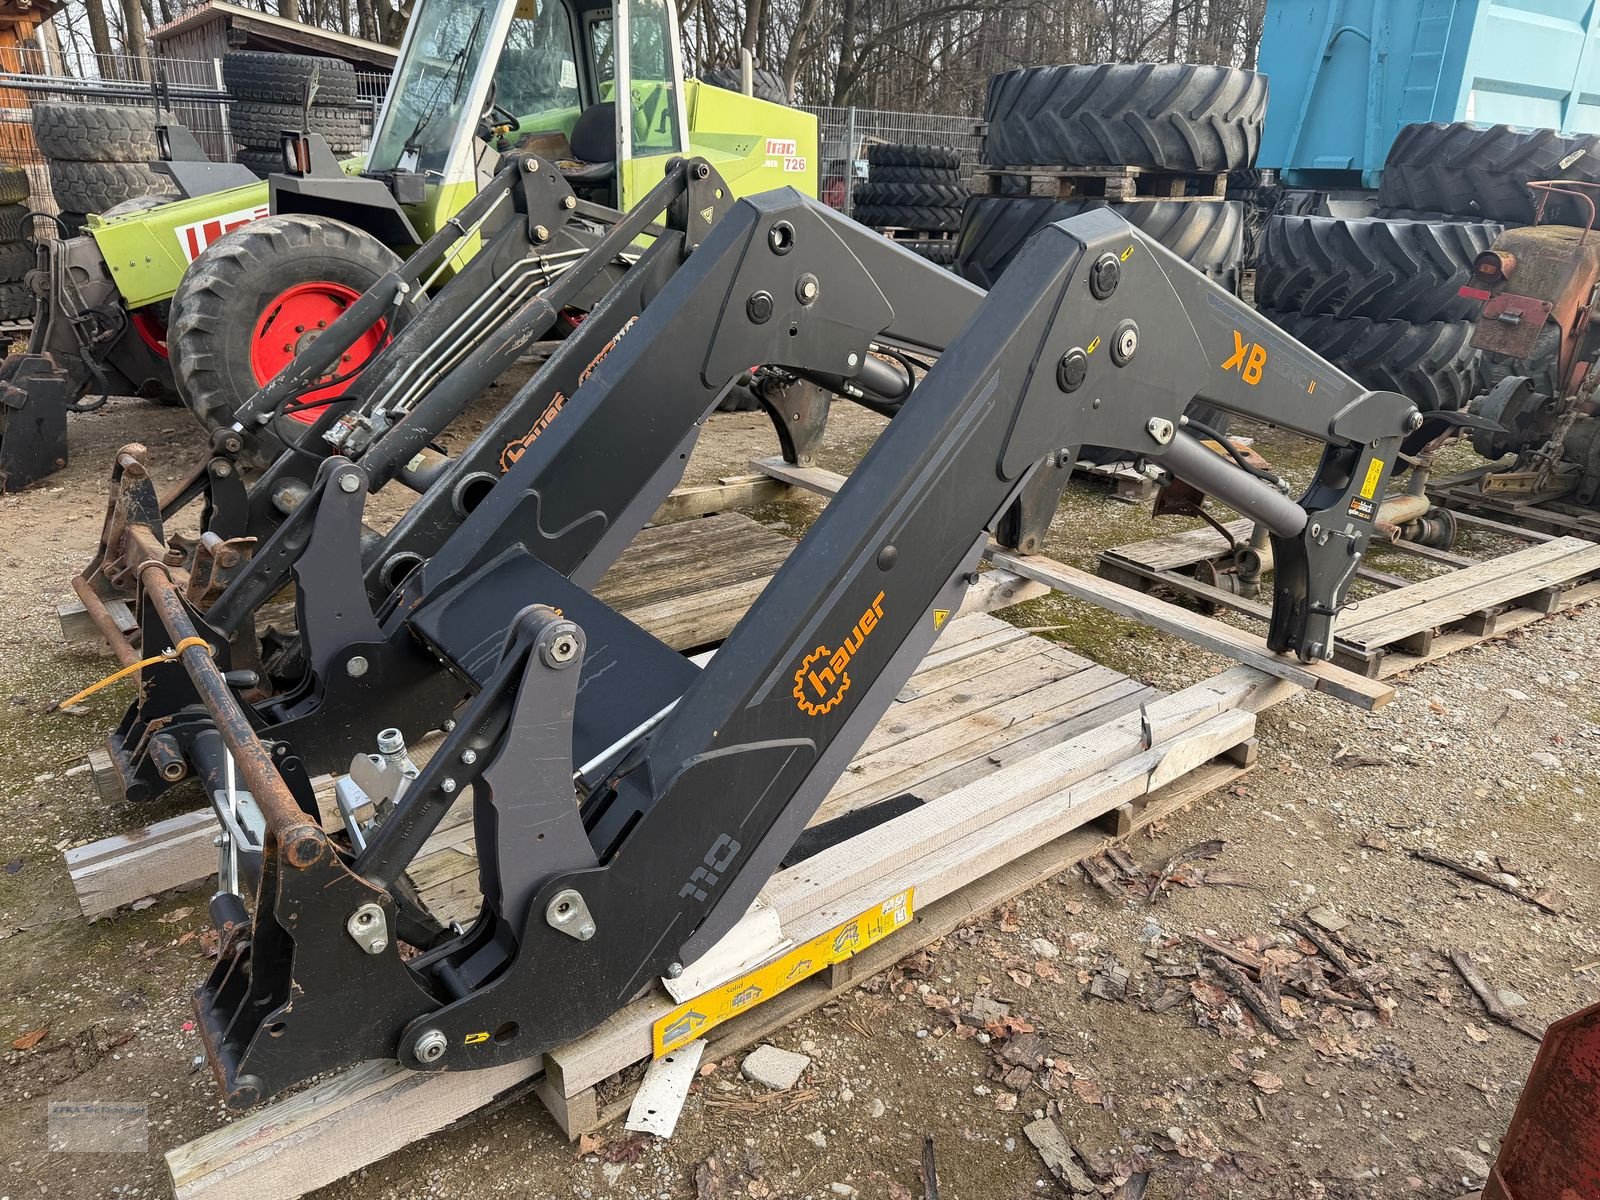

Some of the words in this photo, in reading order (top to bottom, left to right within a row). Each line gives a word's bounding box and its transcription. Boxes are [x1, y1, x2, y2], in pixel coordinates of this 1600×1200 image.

[784, 158, 806, 171] 726
[1220, 329, 1268, 386] XB
[807, 590, 886, 698] hauer
[677, 832, 742, 903] 110
[725, 982, 745, 995] Solid
